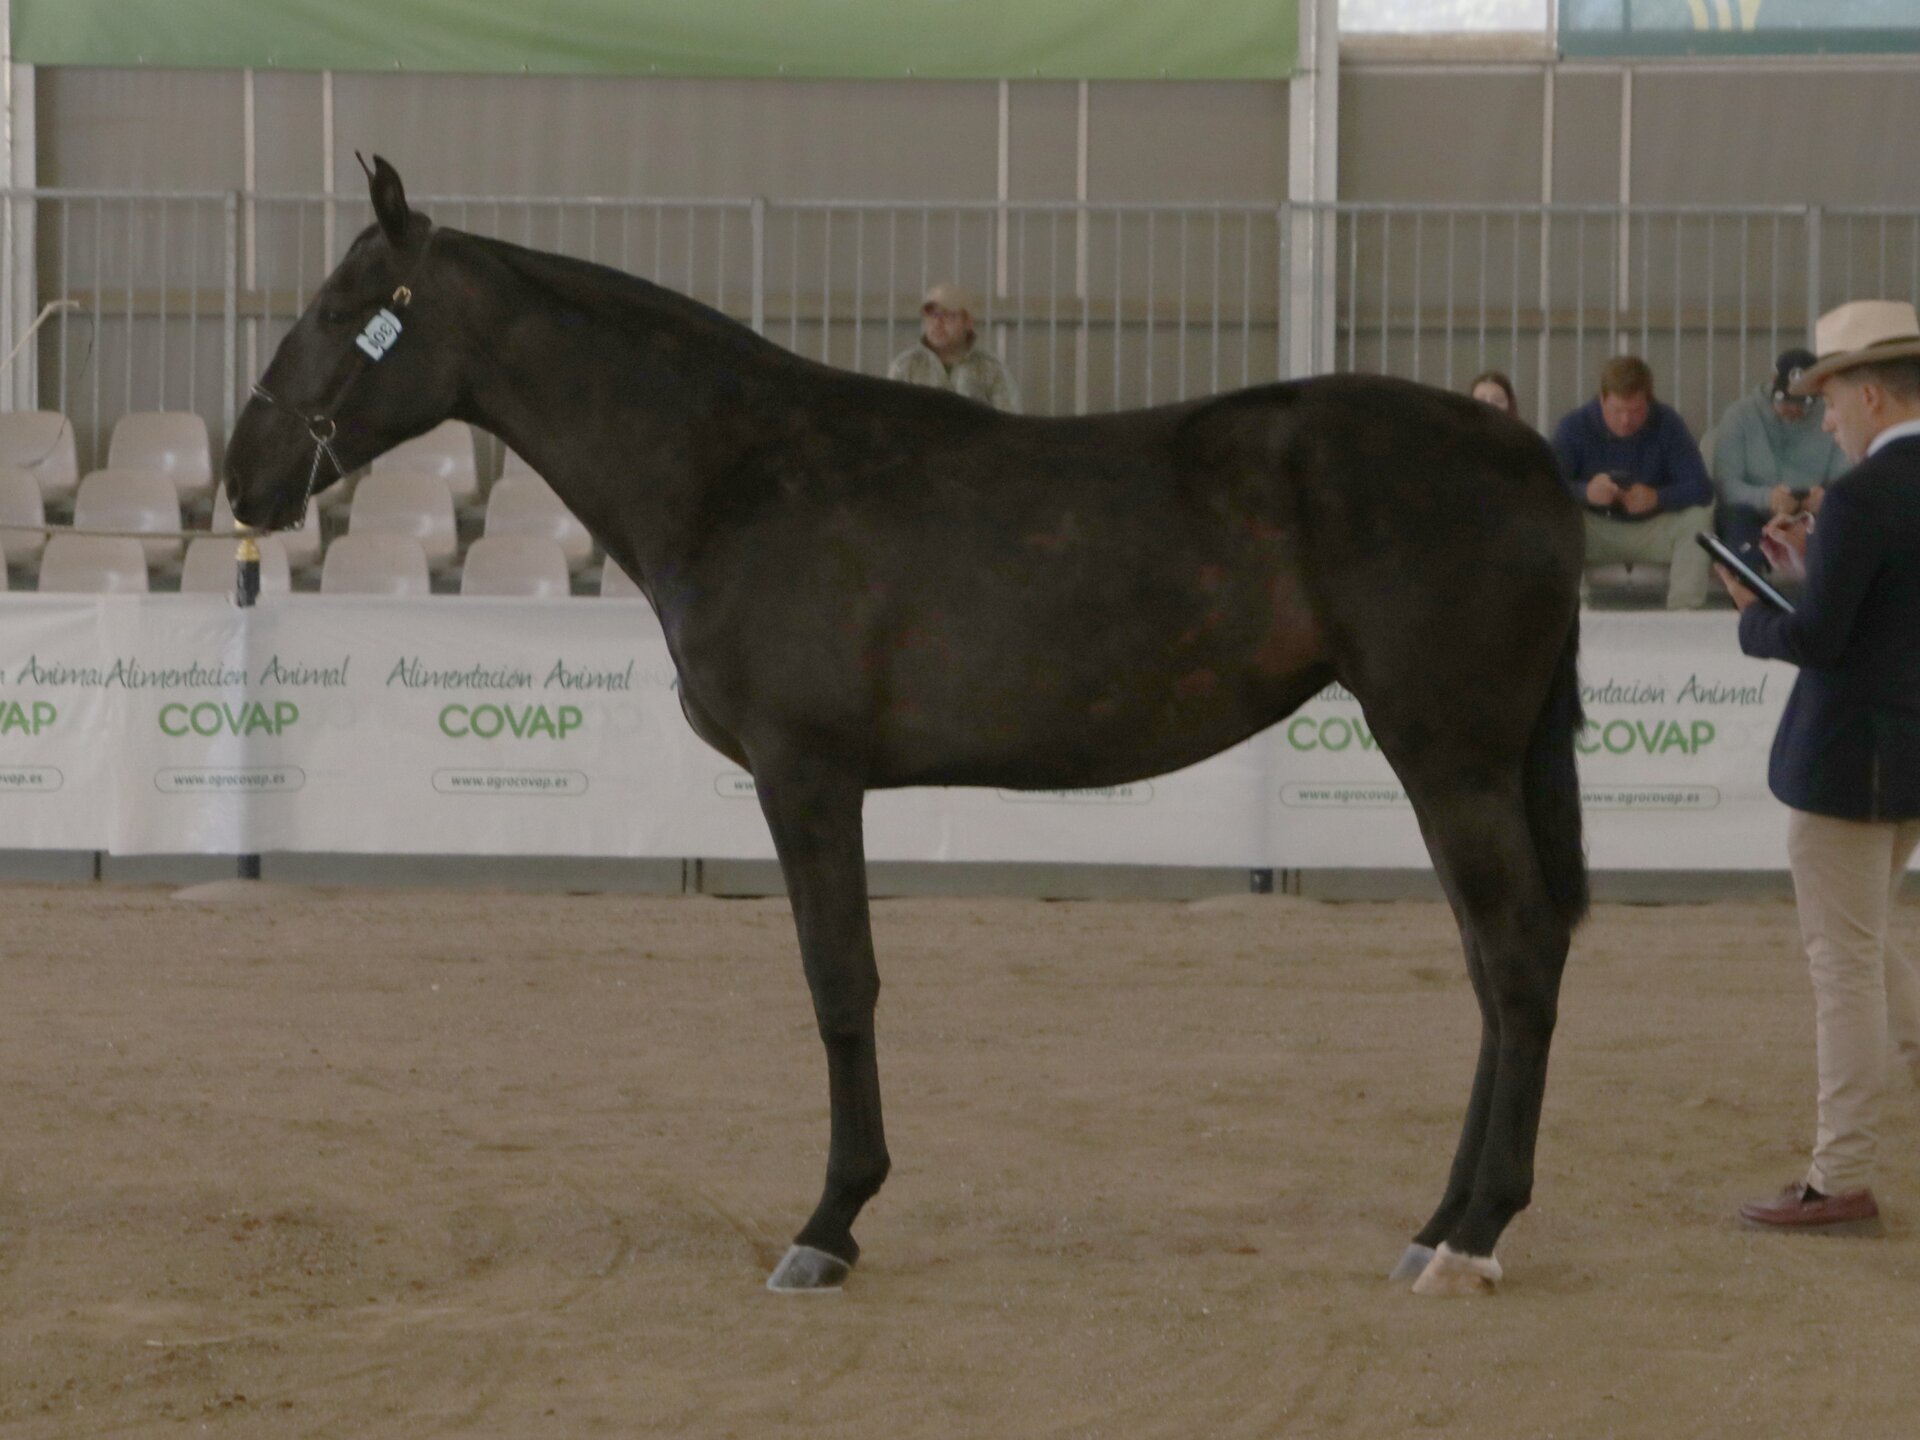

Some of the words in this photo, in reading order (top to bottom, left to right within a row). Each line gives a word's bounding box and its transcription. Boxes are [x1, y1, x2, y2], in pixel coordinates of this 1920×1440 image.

[260, 654, 350, 687] Animal
[386, 656, 532, 689] Alimentación
[544, 658, 635, 691] Animal
[1581, 677, 1665, 705] entación
[1676, 672, 1768, 705] Animal
[158, 701, 299, 737] COVAP
[438, 704, 583, 739] COVAP
[1287, 716, 1381, 751] COV
[1575, 719, 1715, 755] COVAP
[174, 774, 285, 788] www.agrocovap.es
[451, 775, 568, 789] www.agrocovap.es
